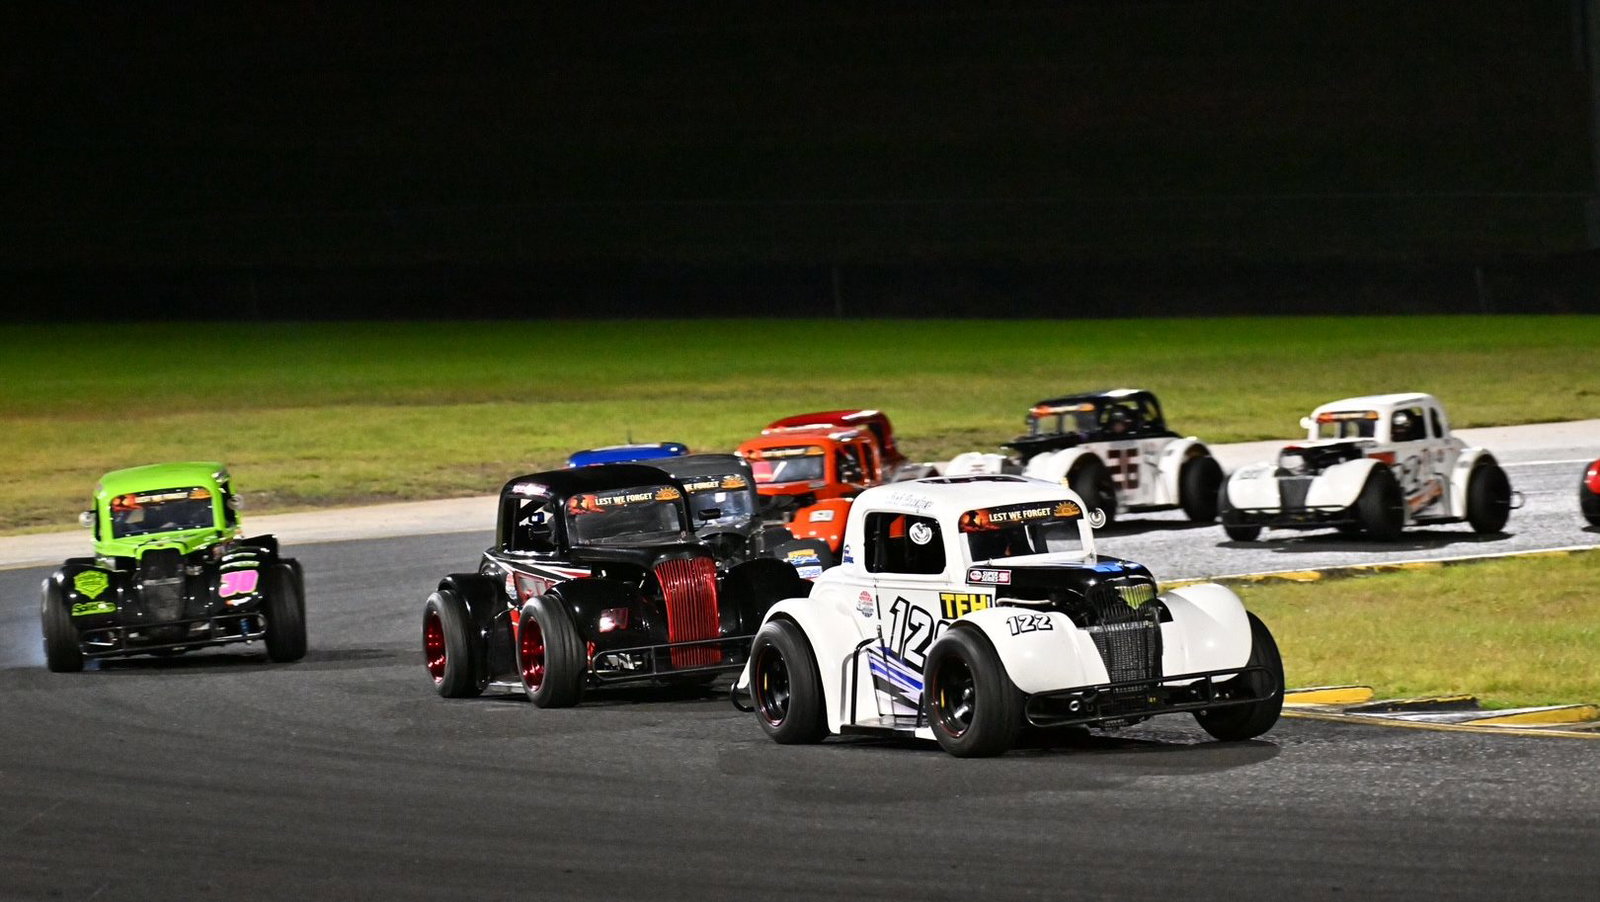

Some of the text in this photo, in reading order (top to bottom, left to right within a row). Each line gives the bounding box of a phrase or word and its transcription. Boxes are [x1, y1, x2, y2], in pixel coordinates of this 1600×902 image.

[595, 492, 653, 506] LEST WE FORGET
[989, 507, 1051, 522] LEST WE FORGET
[1006, 613, 1054, 636] 122
[889, 596, 950, 676] 12
